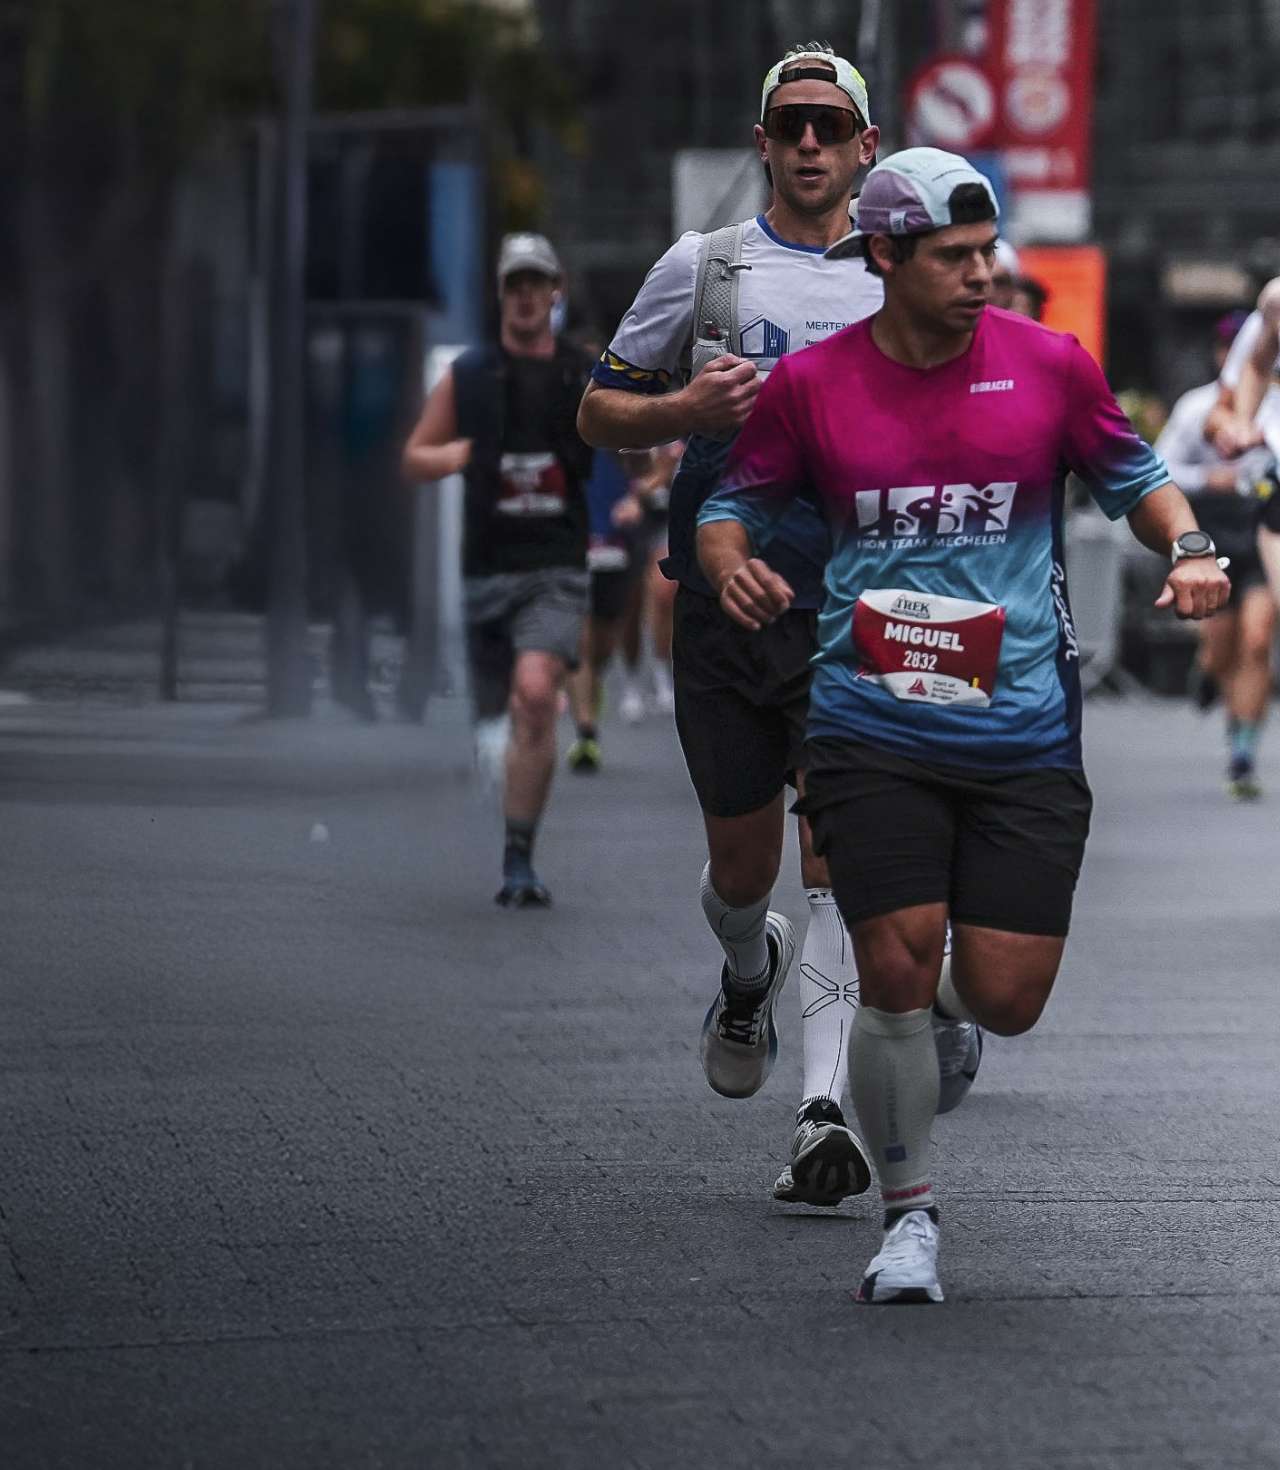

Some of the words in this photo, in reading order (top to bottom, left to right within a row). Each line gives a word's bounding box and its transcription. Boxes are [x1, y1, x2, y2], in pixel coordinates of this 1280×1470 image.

[891, 536, 927, 549] TEAM
[931, 533, 1008, 548] MECHELEN
[894, 599, 931, 613] TREK
[884, 622, 965, 652] MIGUEL
[903, 650, 938, 671] 2832
